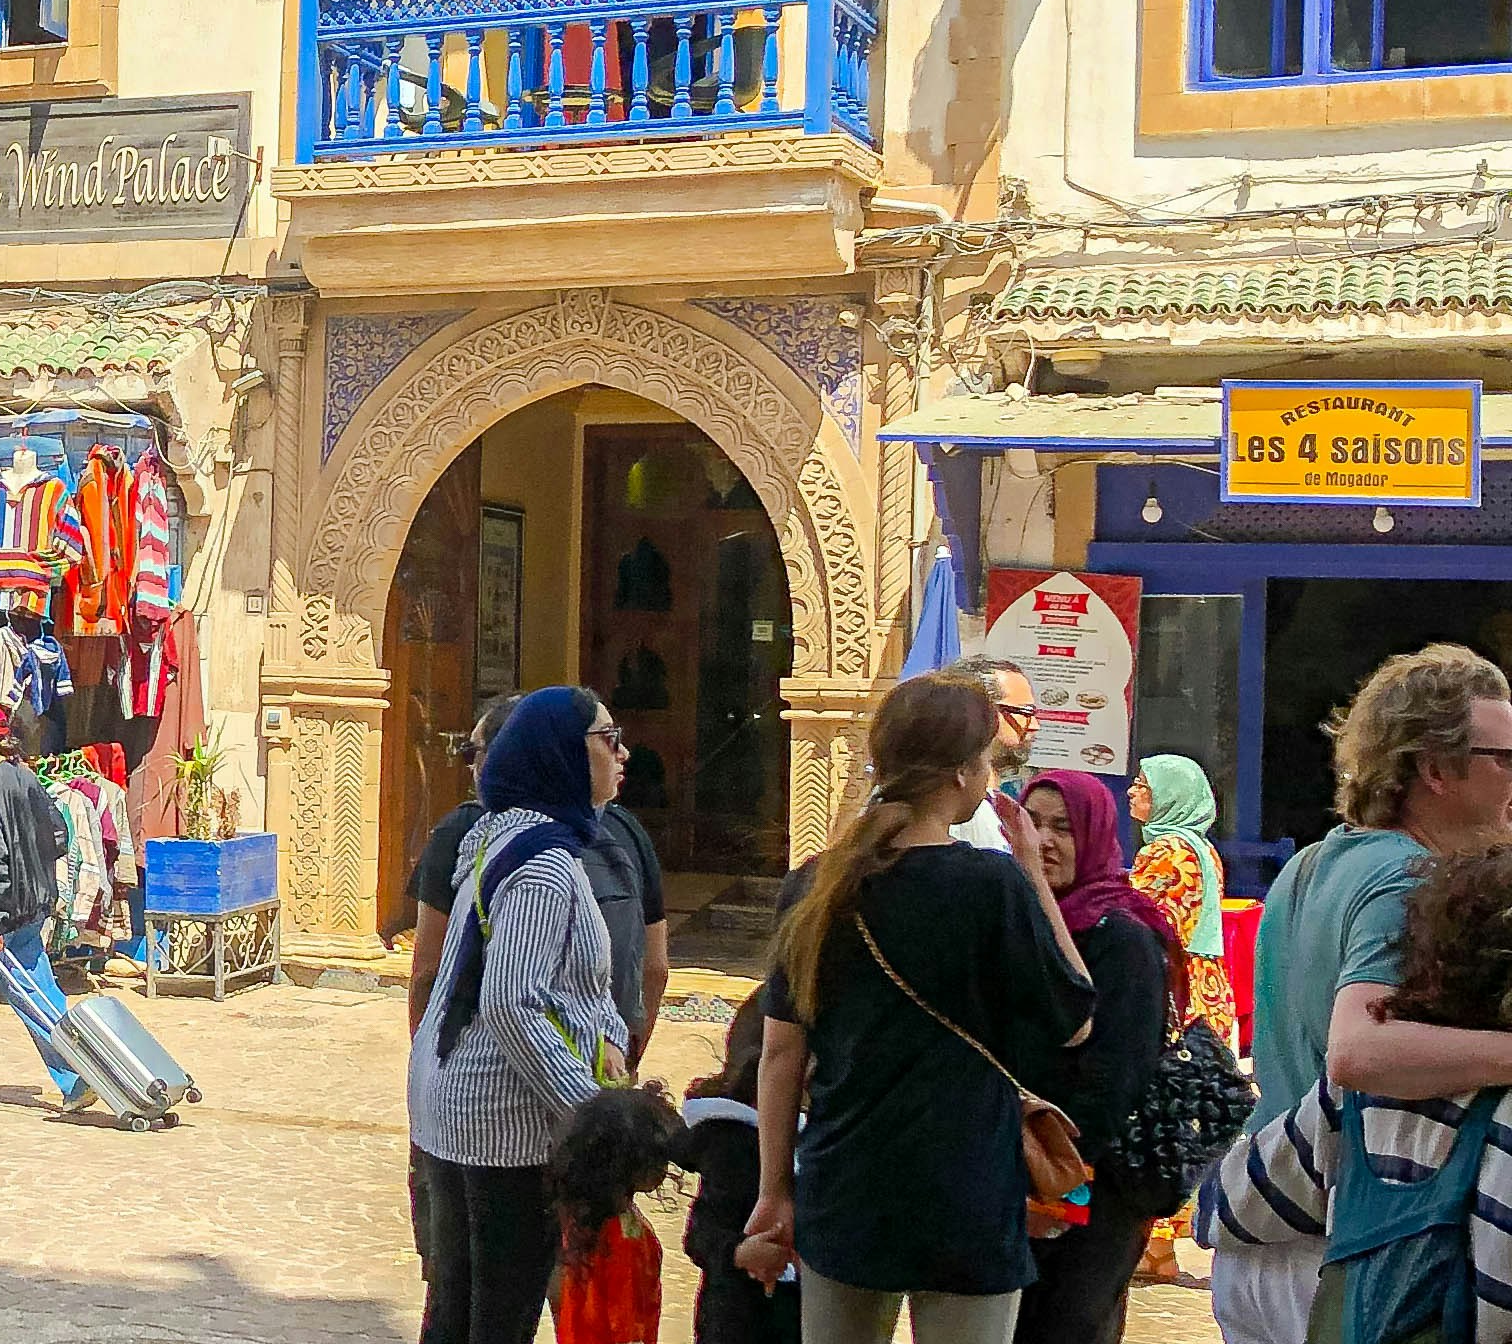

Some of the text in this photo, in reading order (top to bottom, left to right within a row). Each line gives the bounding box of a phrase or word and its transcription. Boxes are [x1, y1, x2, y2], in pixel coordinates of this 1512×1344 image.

[6, 138, 116, 209] Wind
[111, 132, 232, 207] Palace
[1279, 396, 1417, 428] RESTAURANT
[1230, 432, 1466, 466] Les 4 saisons
[1304, 471, 1389, 489] de Mogador
